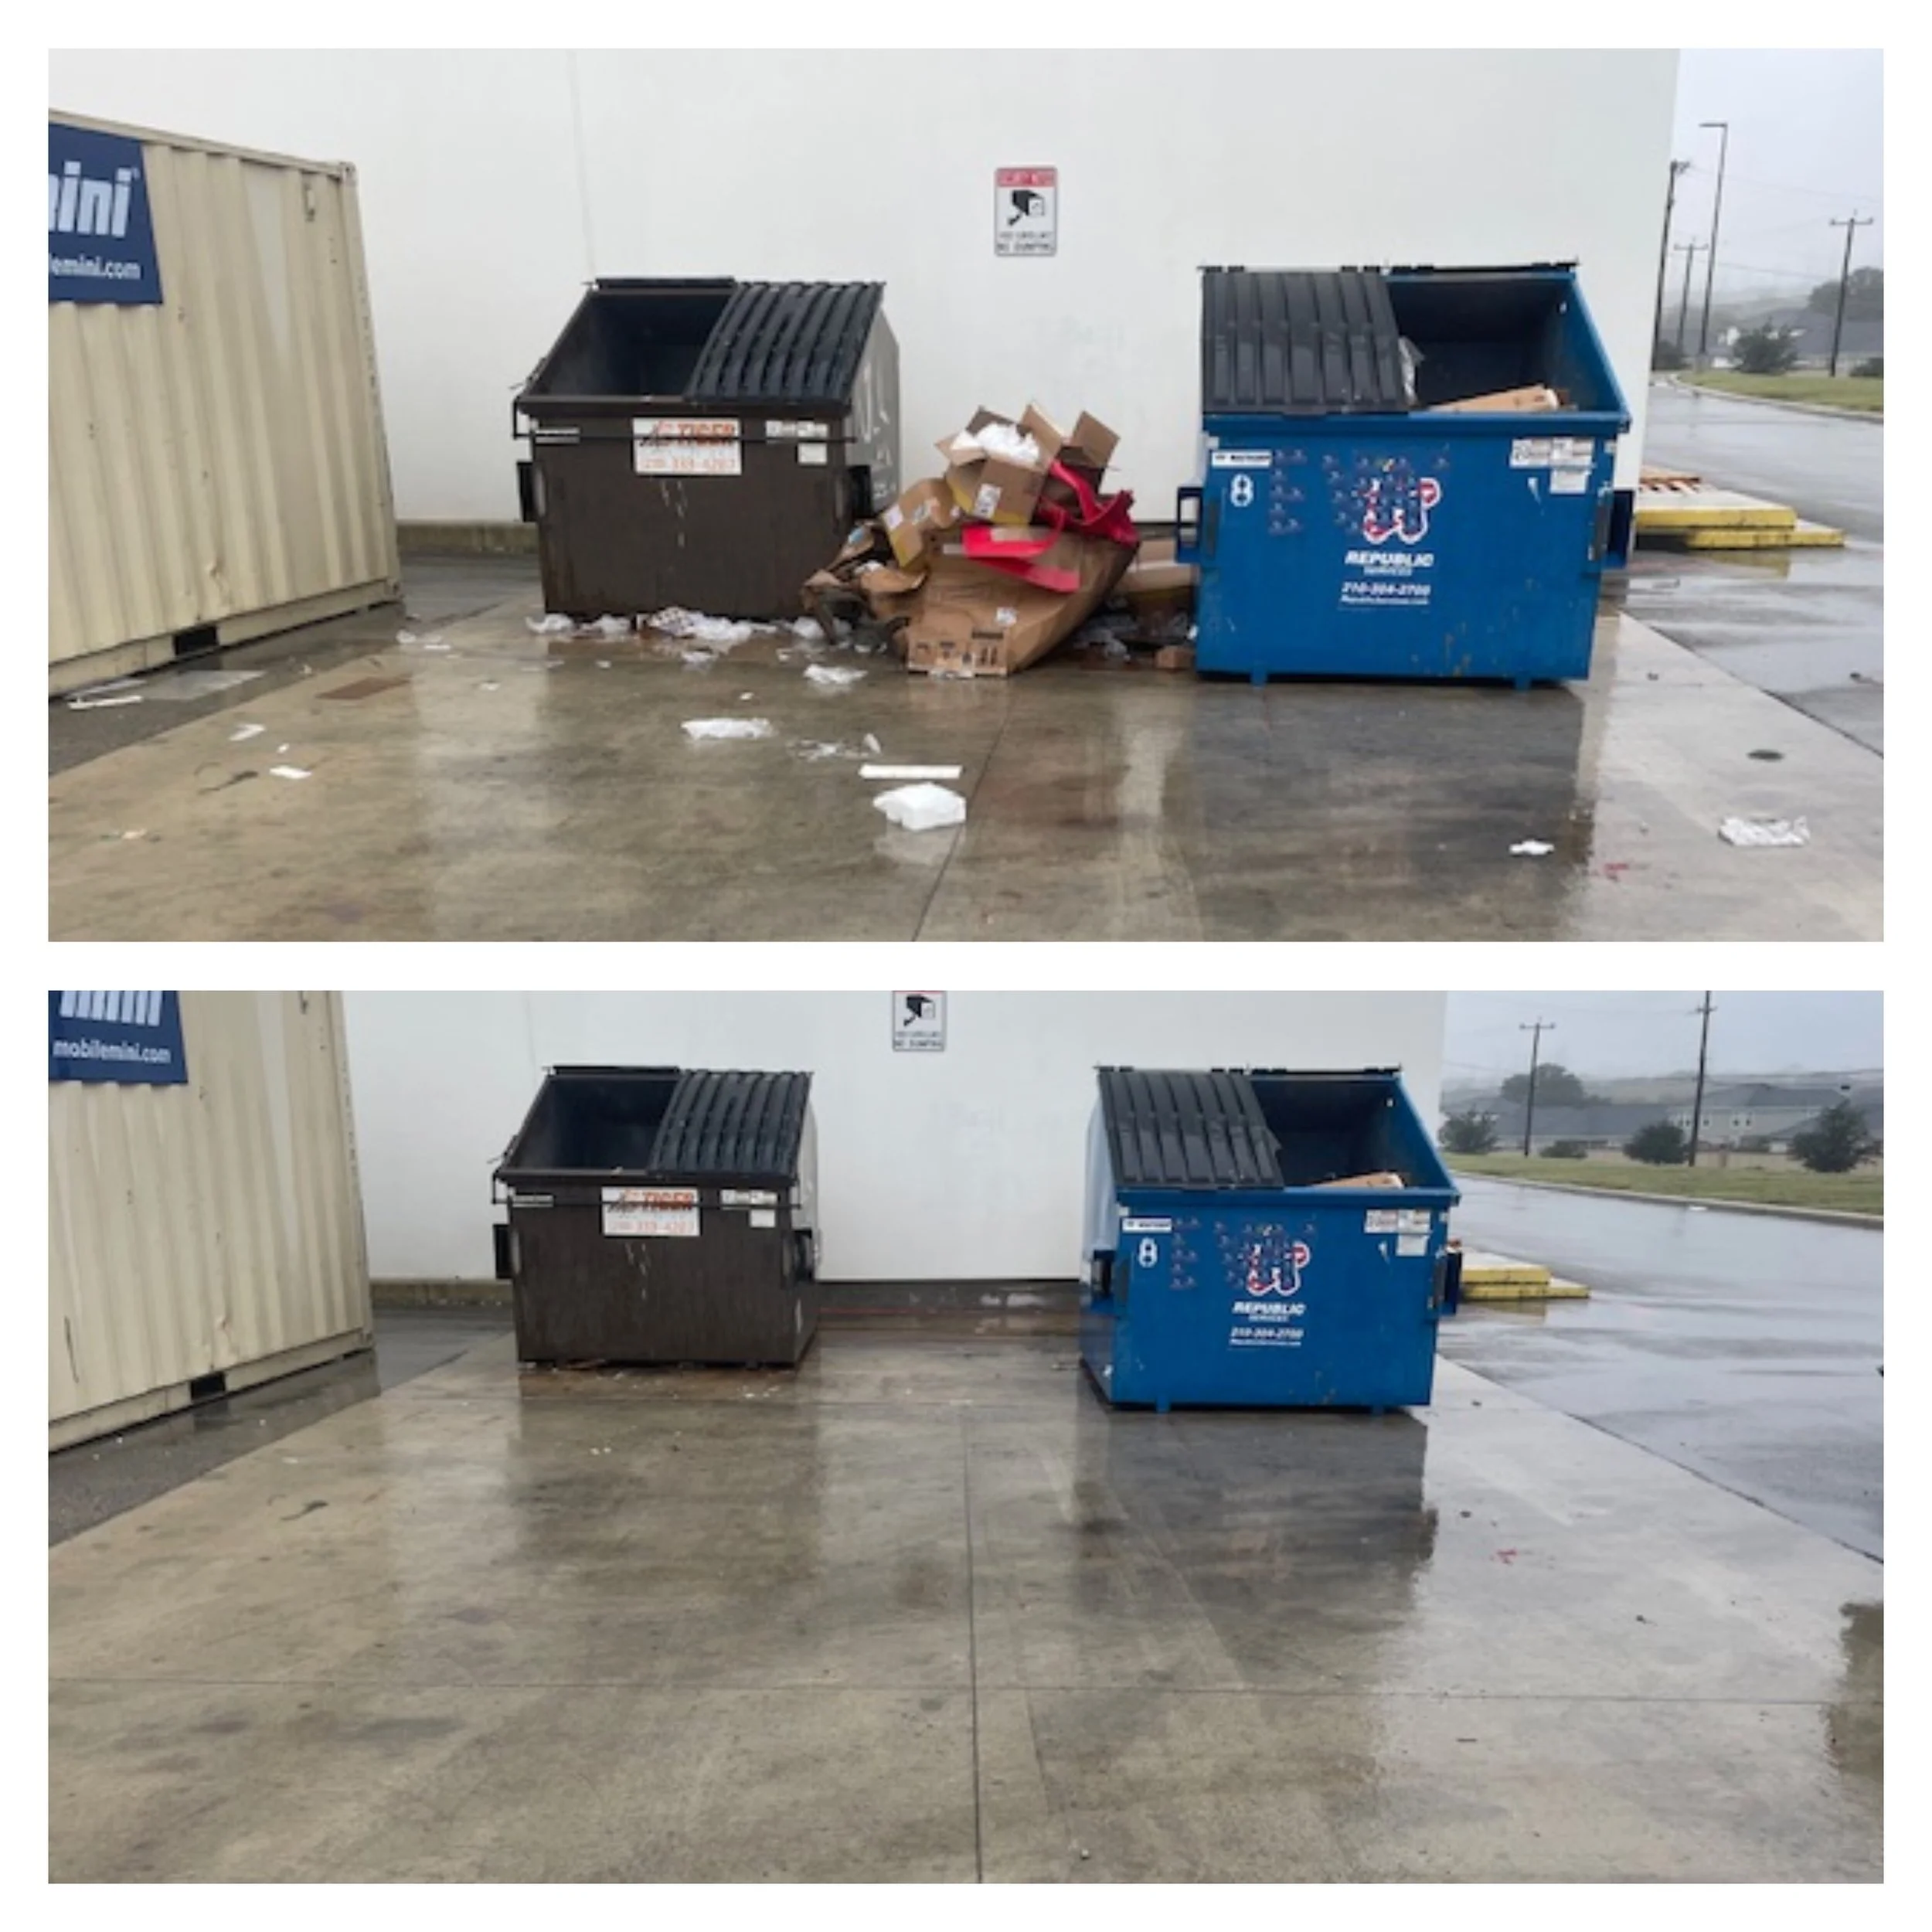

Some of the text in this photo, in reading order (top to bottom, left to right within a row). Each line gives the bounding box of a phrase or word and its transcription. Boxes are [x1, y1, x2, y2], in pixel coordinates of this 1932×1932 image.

[1345, 549, 1435, 567] REPUBLIC
[53, 1038, 172, 1063] mobilemini.com
[1232, 1301, 1307, 1316] REPUBLIC
